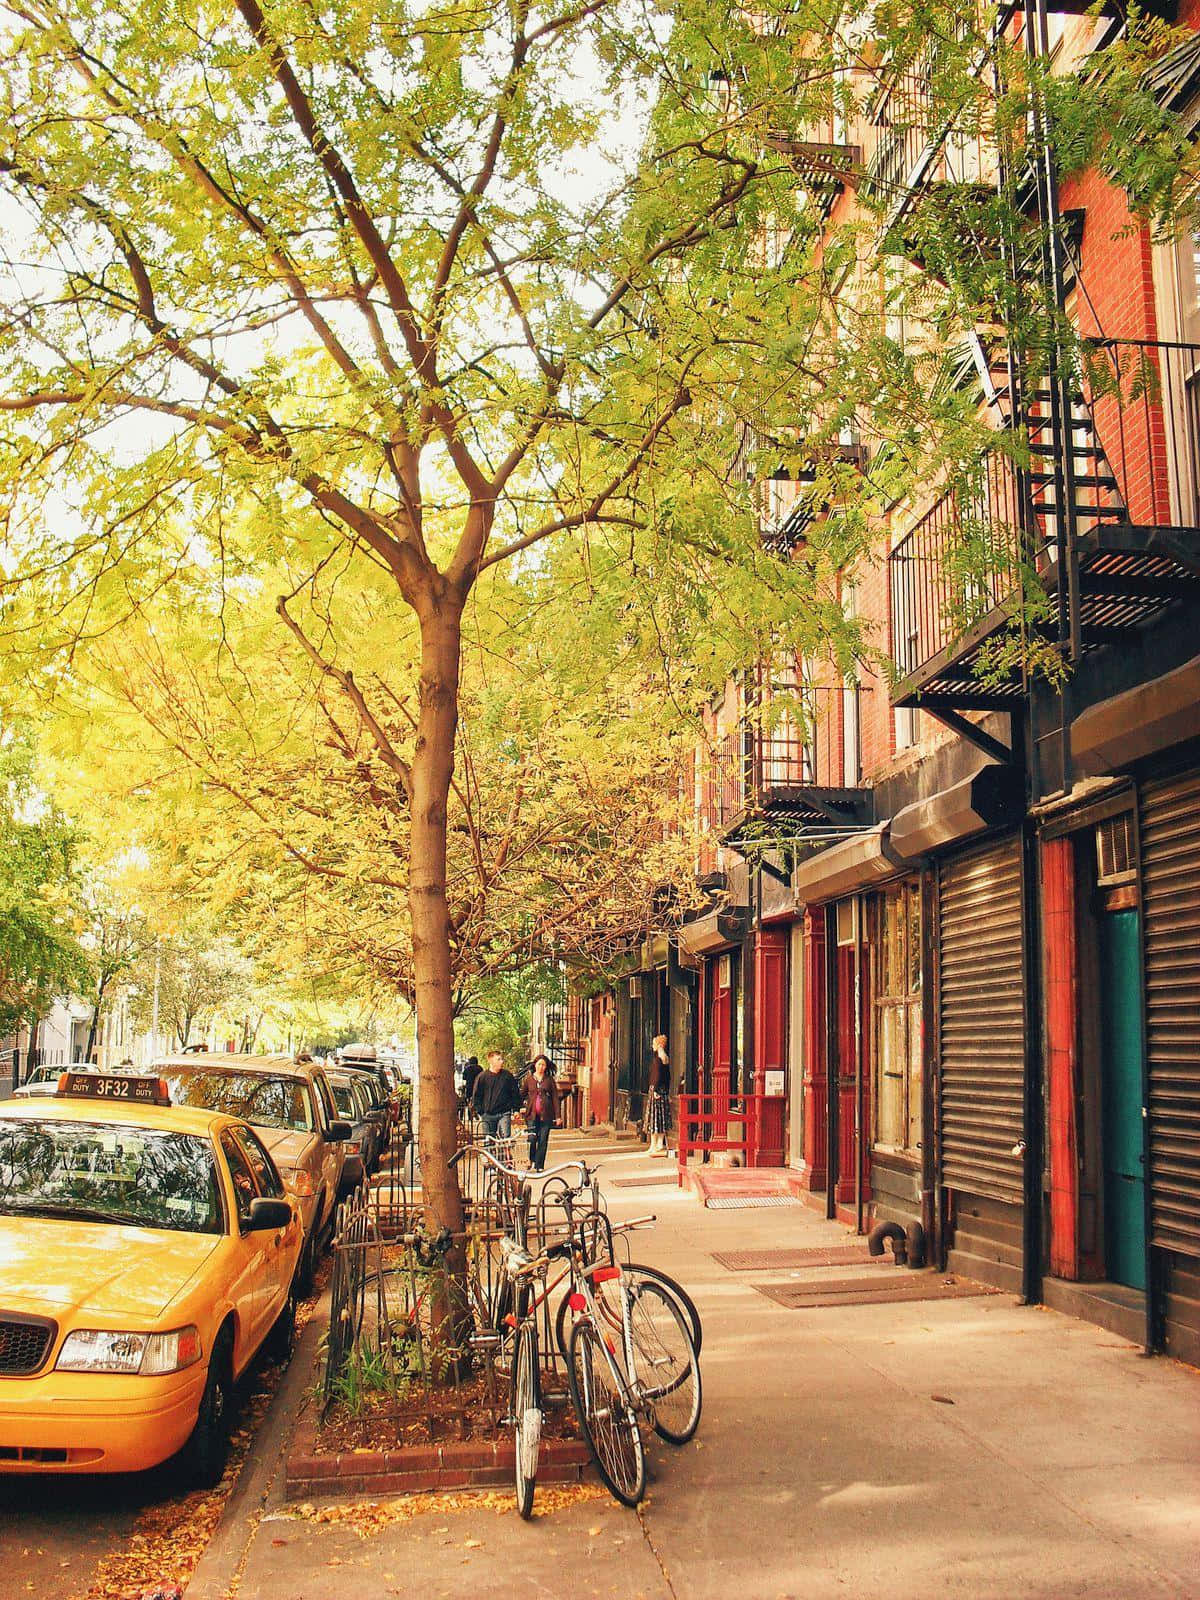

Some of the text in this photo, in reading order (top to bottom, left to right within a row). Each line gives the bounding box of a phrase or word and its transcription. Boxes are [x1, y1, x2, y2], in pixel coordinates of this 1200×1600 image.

[72, 1083, 90, 1092] DUTY
[97, 1079, 129, 1097] 3F32
[135, 1088, 153, 1097] DUTY
